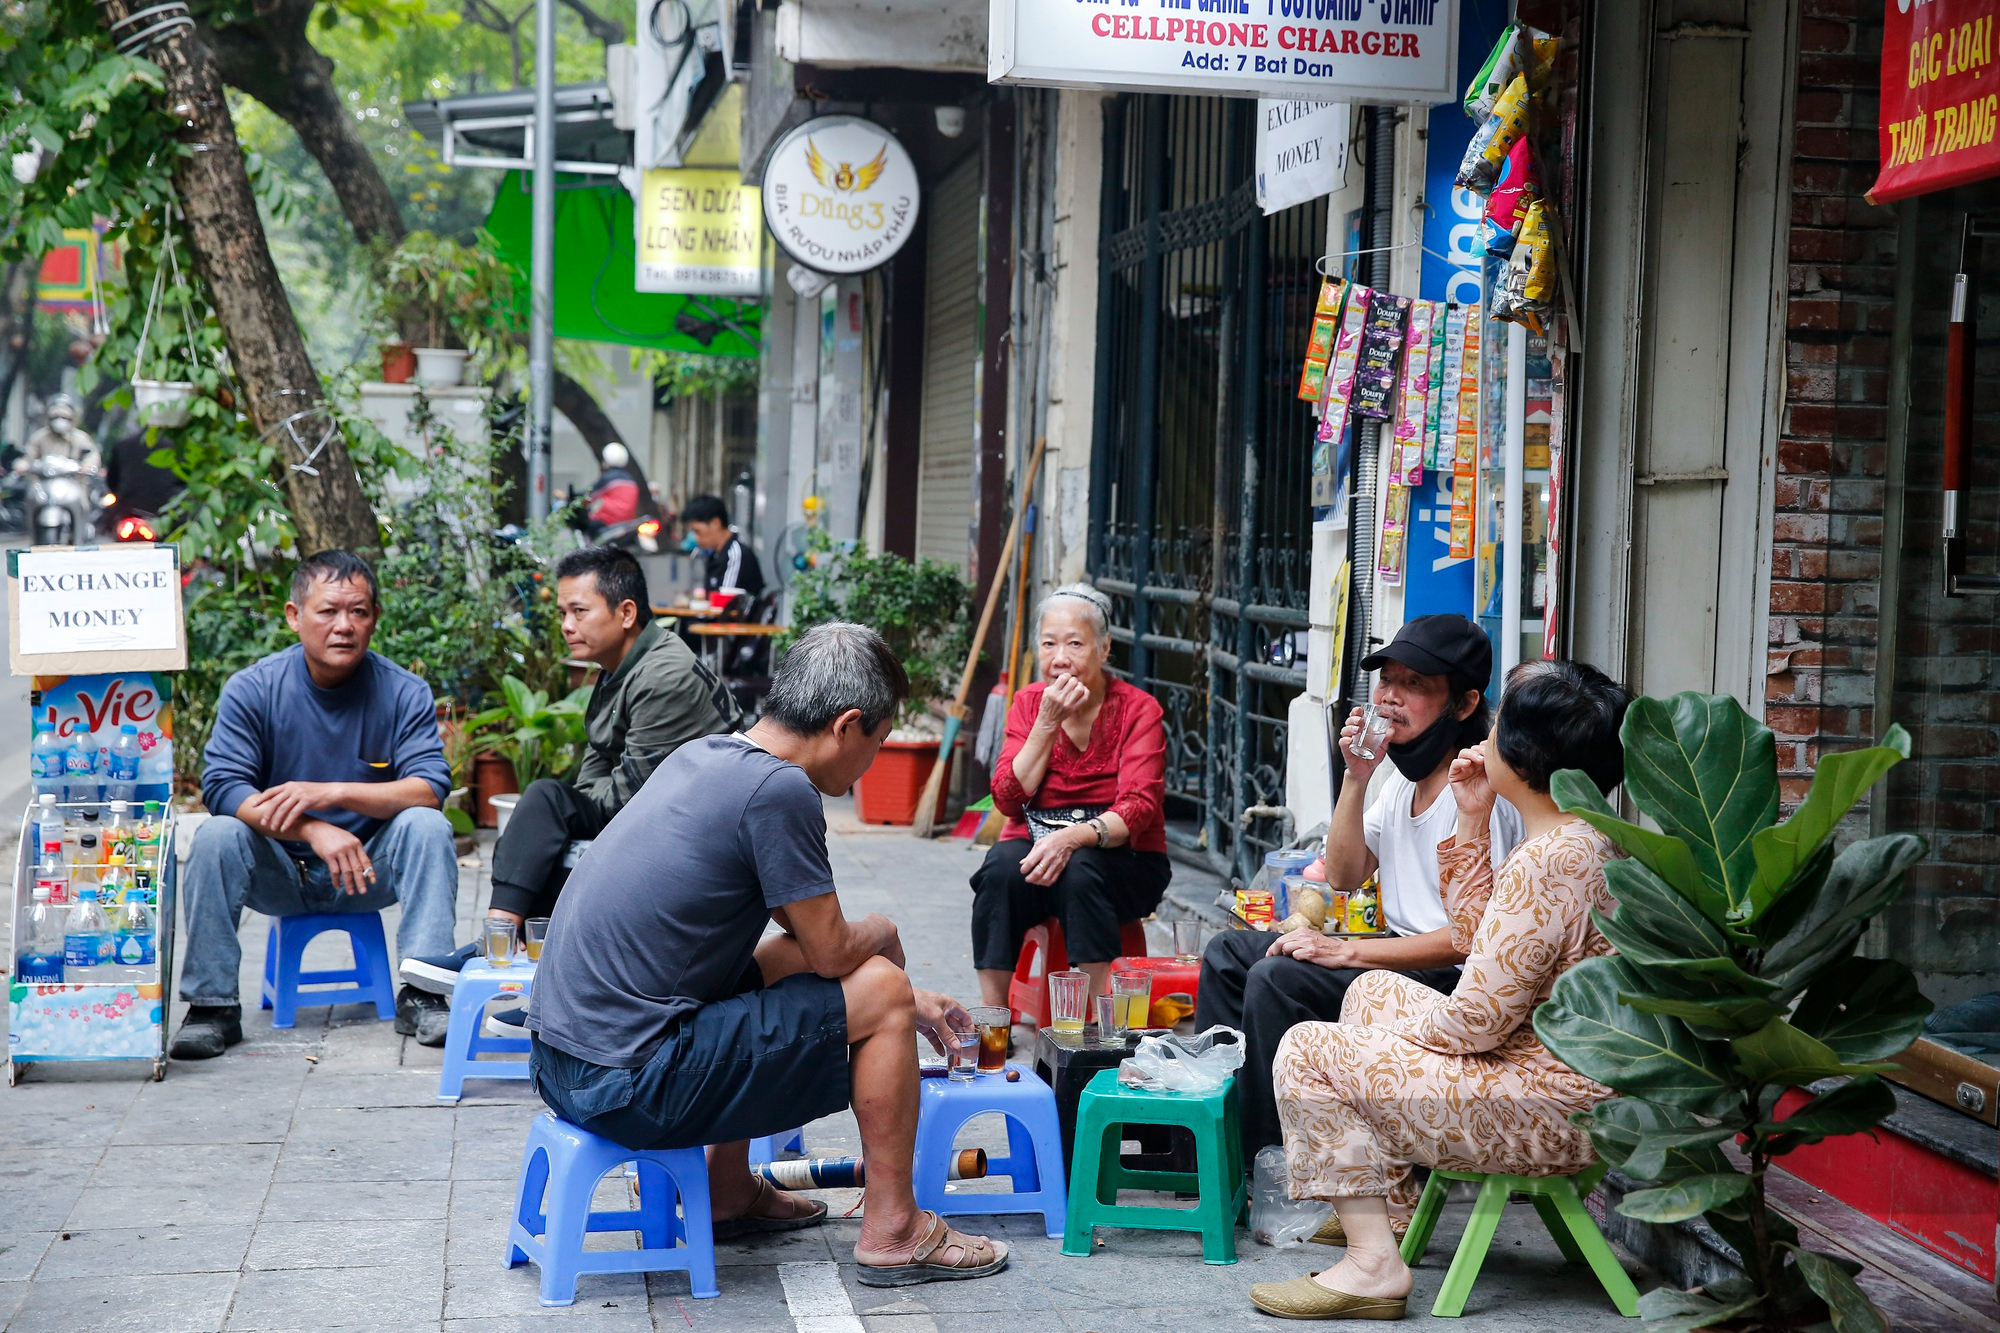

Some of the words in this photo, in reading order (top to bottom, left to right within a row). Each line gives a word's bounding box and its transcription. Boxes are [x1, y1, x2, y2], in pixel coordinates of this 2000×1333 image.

[1092, 13, 1268, 48] CELLPHONE
[1278, 26, 1420, 58] CHARGER
[1181, 50, 1229, 71] Add:
[1237, 54, 1247, 72] 7
[1254, 56, 1287, 74] Bat
[1294, 58, 1333, 77] Dan
[1908, 27, 1942, 89] CÁC
[1947, 15, 1993, 79] LOẠI
[1889, 105, 1927, 169] THỜI
[1930, 94, 1998, 157] TRANG
[1275, 137, 1322, 176] MONEY
[660, 188, 698, 212] SEN
[775, 183, 789, 215] BIA
[647, 226, 696, 250] LONG
[1377, 308, 1401, 320] Downy
[1369, 348, 1393, 360] Downy
[1361, 388, 1385, 401] Downy
[23, 571, 167, 593] EXCHANGE
[49, 608, 144, 628] MONEY
